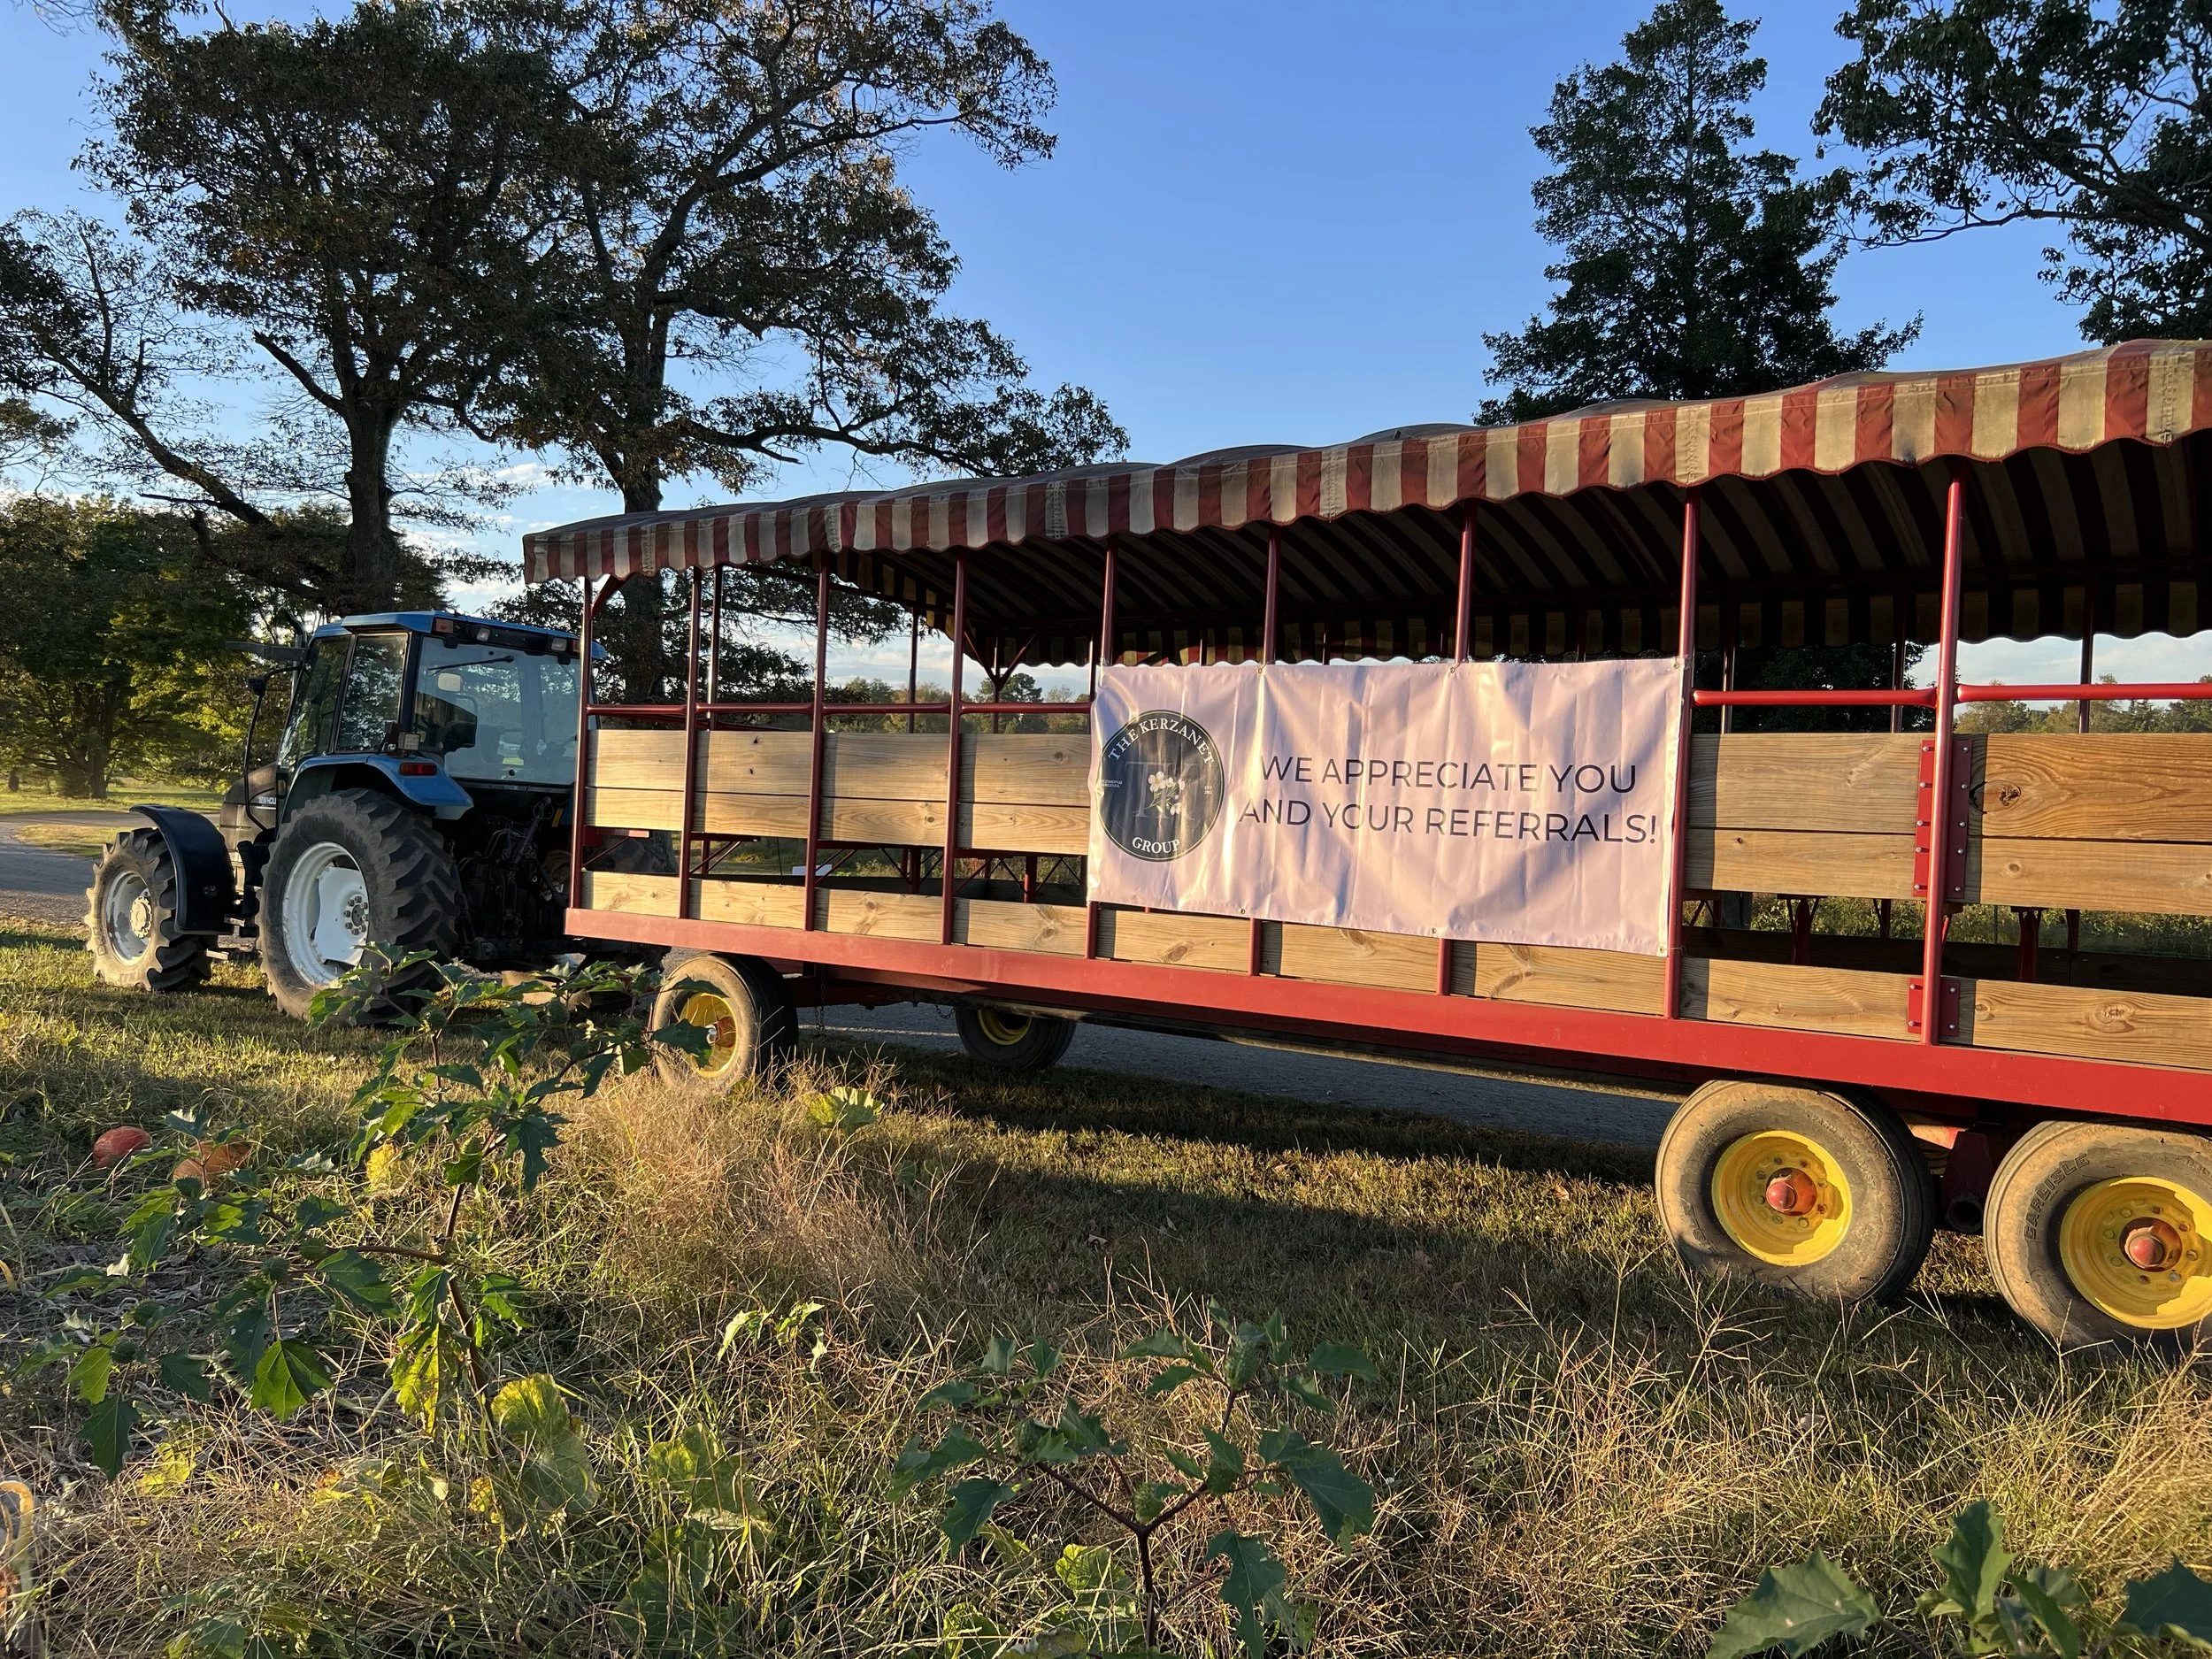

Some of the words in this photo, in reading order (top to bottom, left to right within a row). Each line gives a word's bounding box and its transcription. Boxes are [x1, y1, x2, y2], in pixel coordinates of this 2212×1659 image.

[1108, 728, 1139, 761] THE
[1139, 718, 1215, 765] KERZANET
[1260, 755, 1312, 783] WE
[1321, 757, 1538, 793] APPRECIATE
[1548, 764, 1636, 794] YOU
[1239, 797, 1311, 826] AND
[1321, 802, 1413, 833] YOUR
[1425, 808, 1657, 844] REFERRALS!
[1132, 836, 1180, 854] GROUP
[2024, 1153, 2090, 1240] CARLISLE
